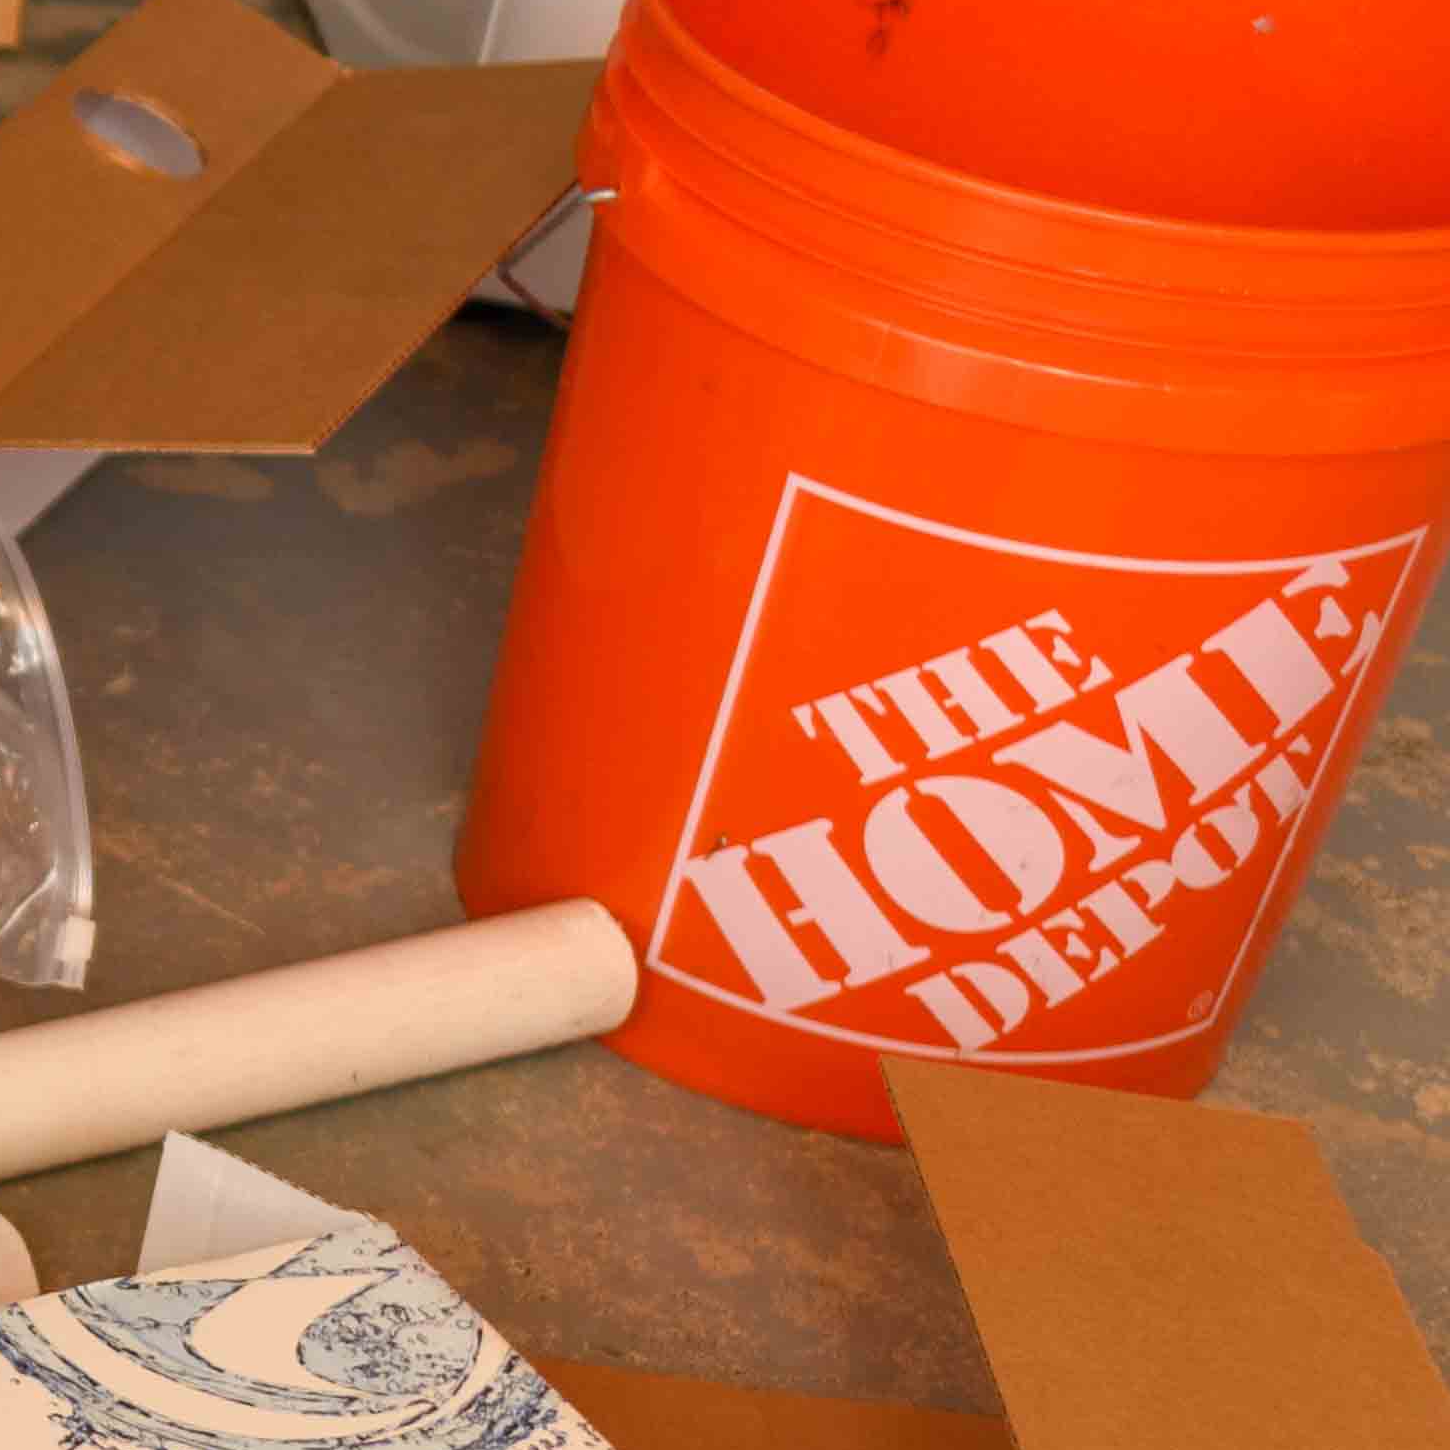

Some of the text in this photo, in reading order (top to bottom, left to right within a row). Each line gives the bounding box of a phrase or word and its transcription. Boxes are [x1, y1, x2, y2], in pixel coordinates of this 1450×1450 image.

[684, 556, 1383, 1012] HOME
[790, 608, 1116, 786] THE
[904, 733, 1316, 1056] DEPOT
